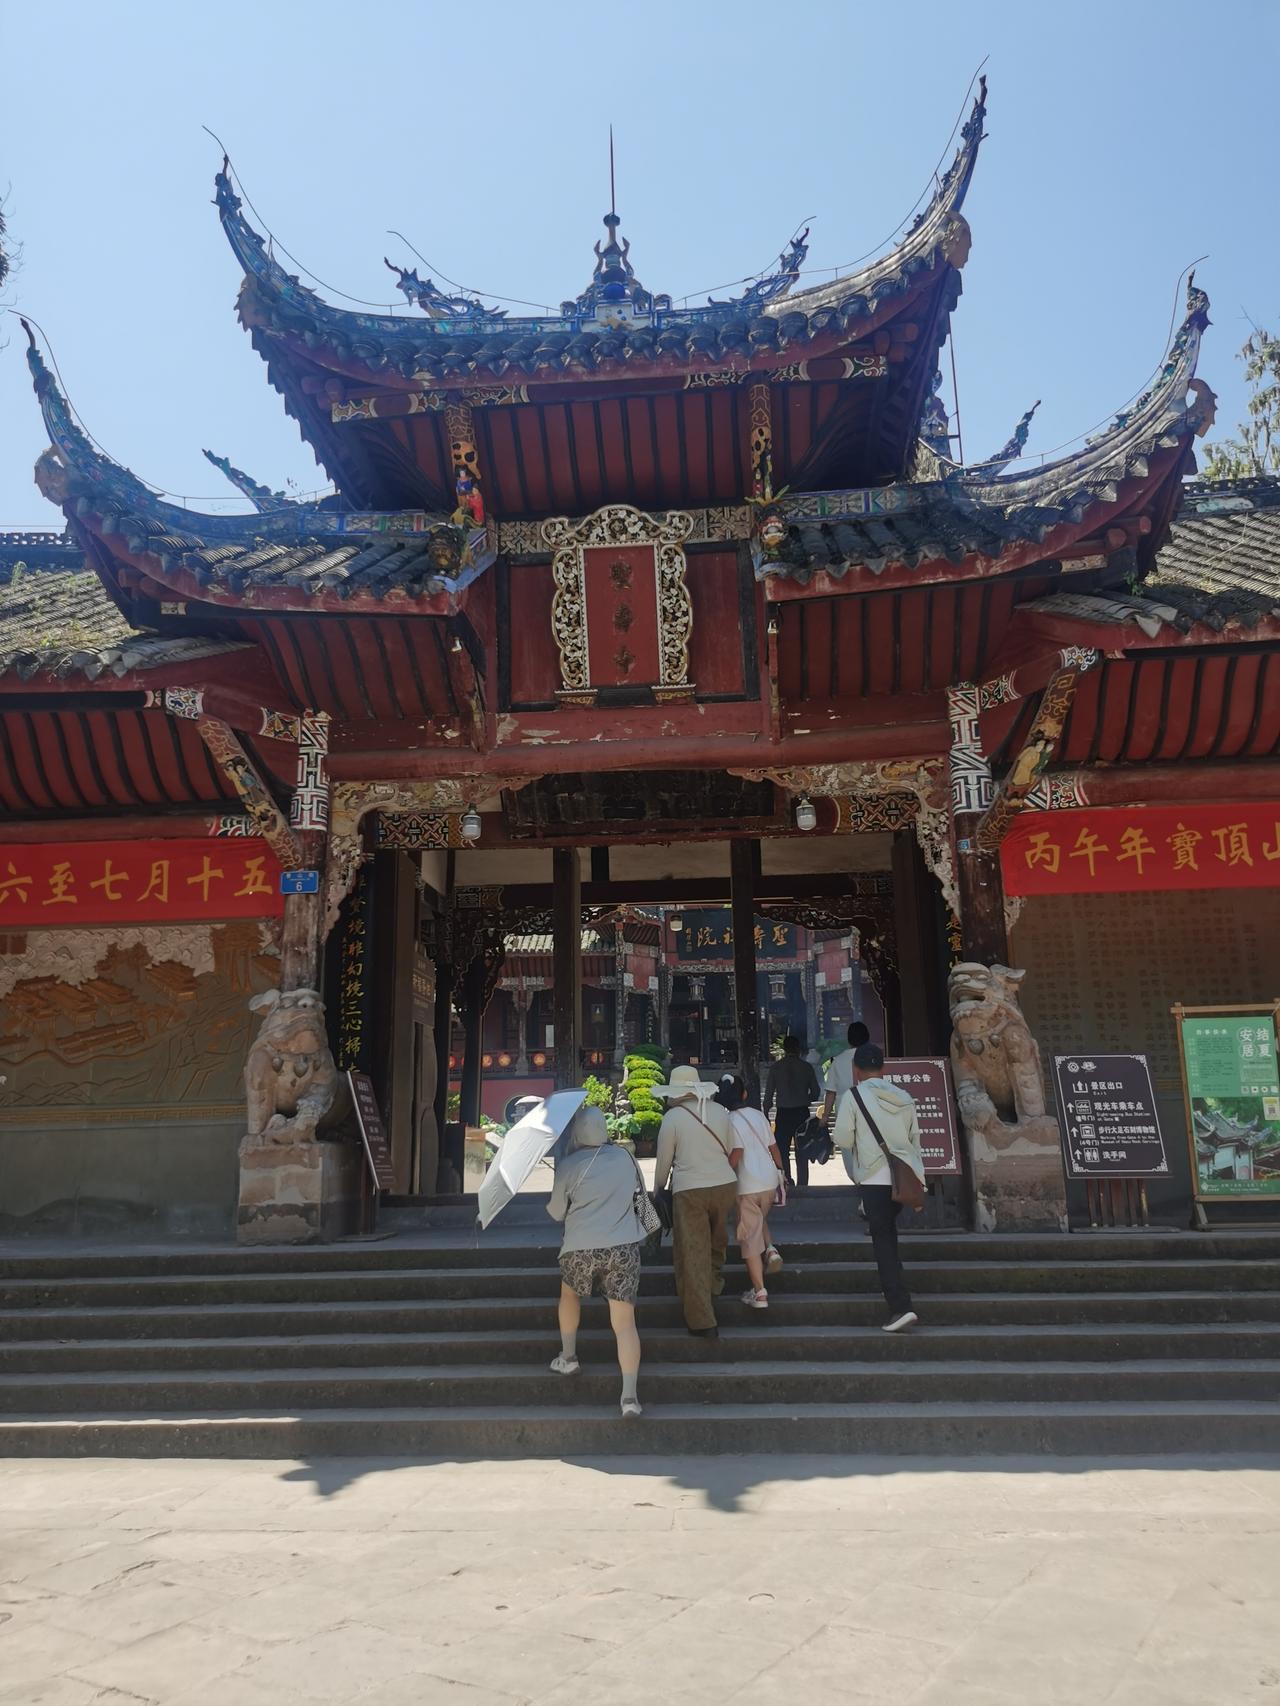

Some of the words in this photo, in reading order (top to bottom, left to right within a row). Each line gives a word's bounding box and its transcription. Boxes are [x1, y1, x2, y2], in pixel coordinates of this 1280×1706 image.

[1023, 821, 1280, 876] 丙午年寶頂山
[0, 856, 273, 905] 六至七月十五
[296, 881, 303, 892] 6
[1090, 1081, 1123, 1090] 景区出口
[1093, 1101, 1144, 1111] 观光车乘车点
[1102, 1150, 1127, 1160] 洗手间
